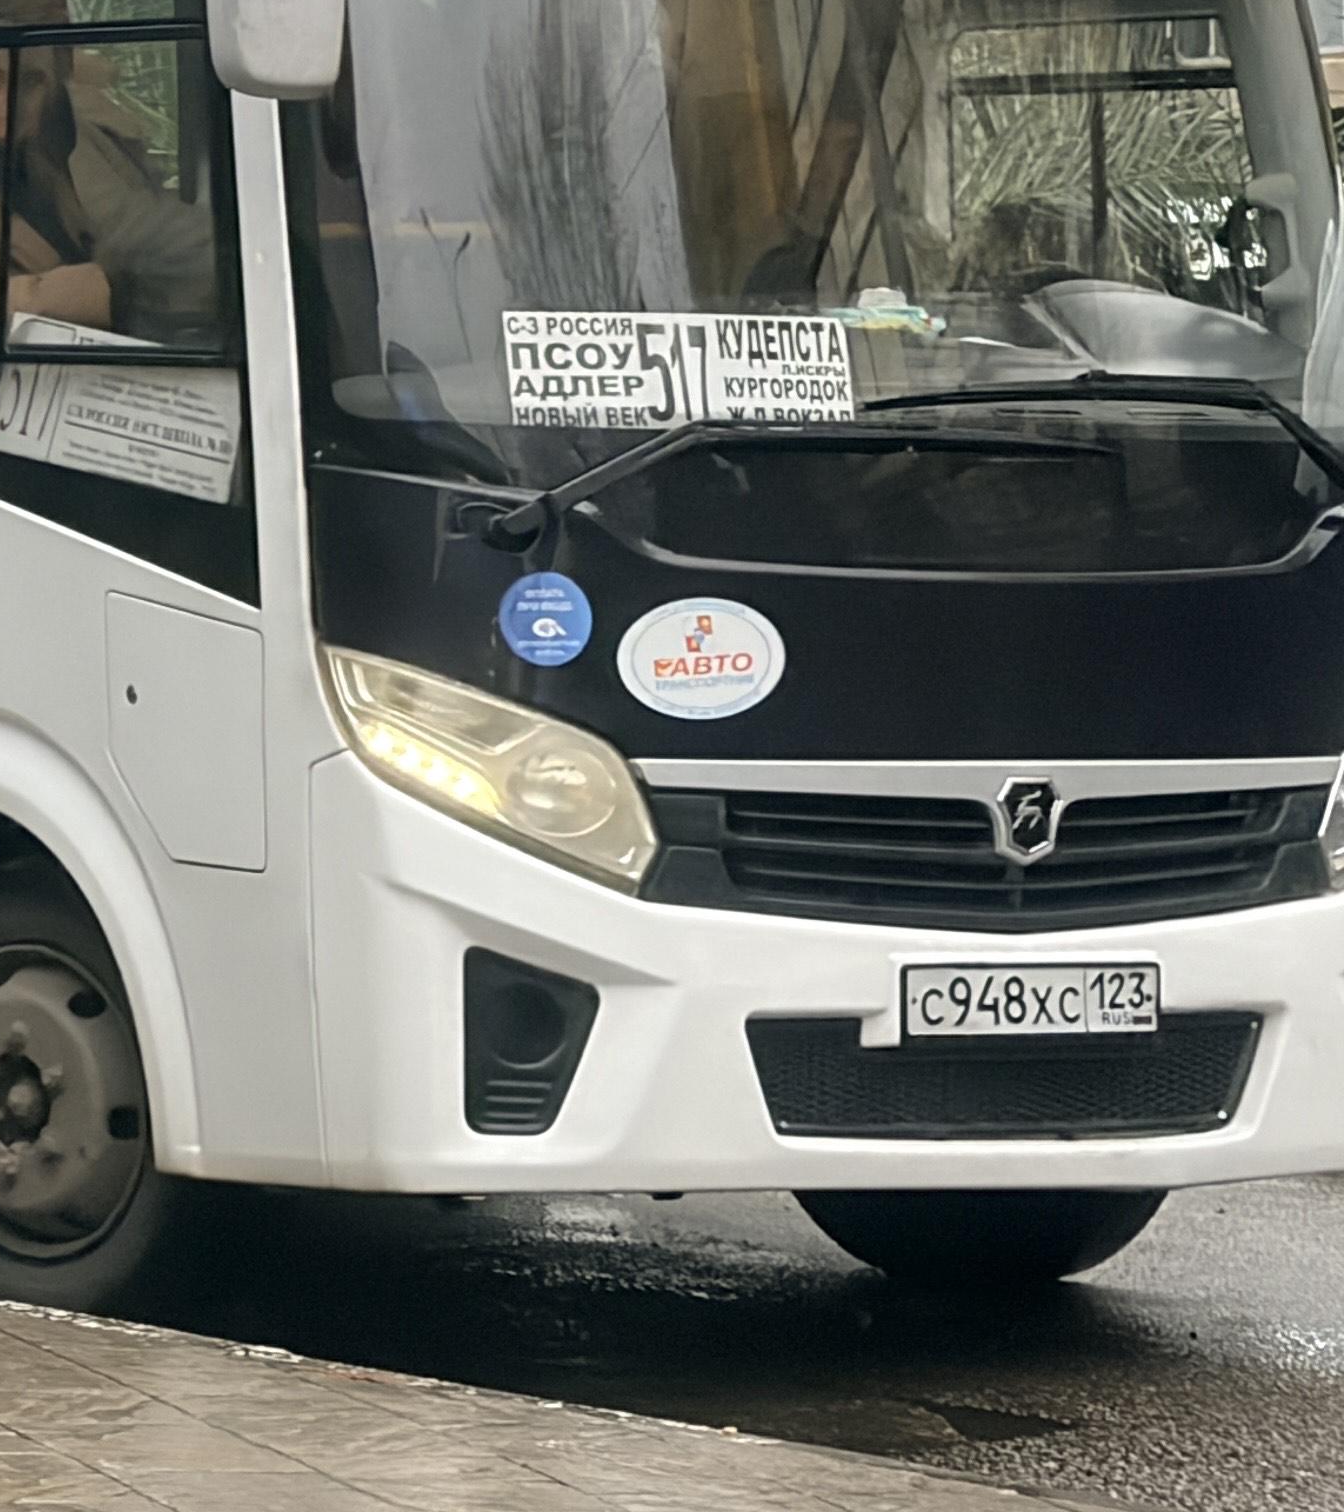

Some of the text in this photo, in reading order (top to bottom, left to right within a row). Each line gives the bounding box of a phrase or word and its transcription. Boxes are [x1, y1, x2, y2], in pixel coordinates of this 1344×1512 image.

[545, 317, 634, 336] РОССИЯ
[510, 342, 634, 370] ПСОУ
[715, 319, 845, 369] КУДЕПСТА
[636, 323, 709, 421] 517
[514, 375, 645, 401] АДЛЕР
[723, 376, 849, 404] КУРГОРОДОК
[515, 403, 649, 427] НОВЫЙ ВЕК
[1089, 972, 1146, 1010] 123
[1101, 1013, 1132, 1026] RUS
